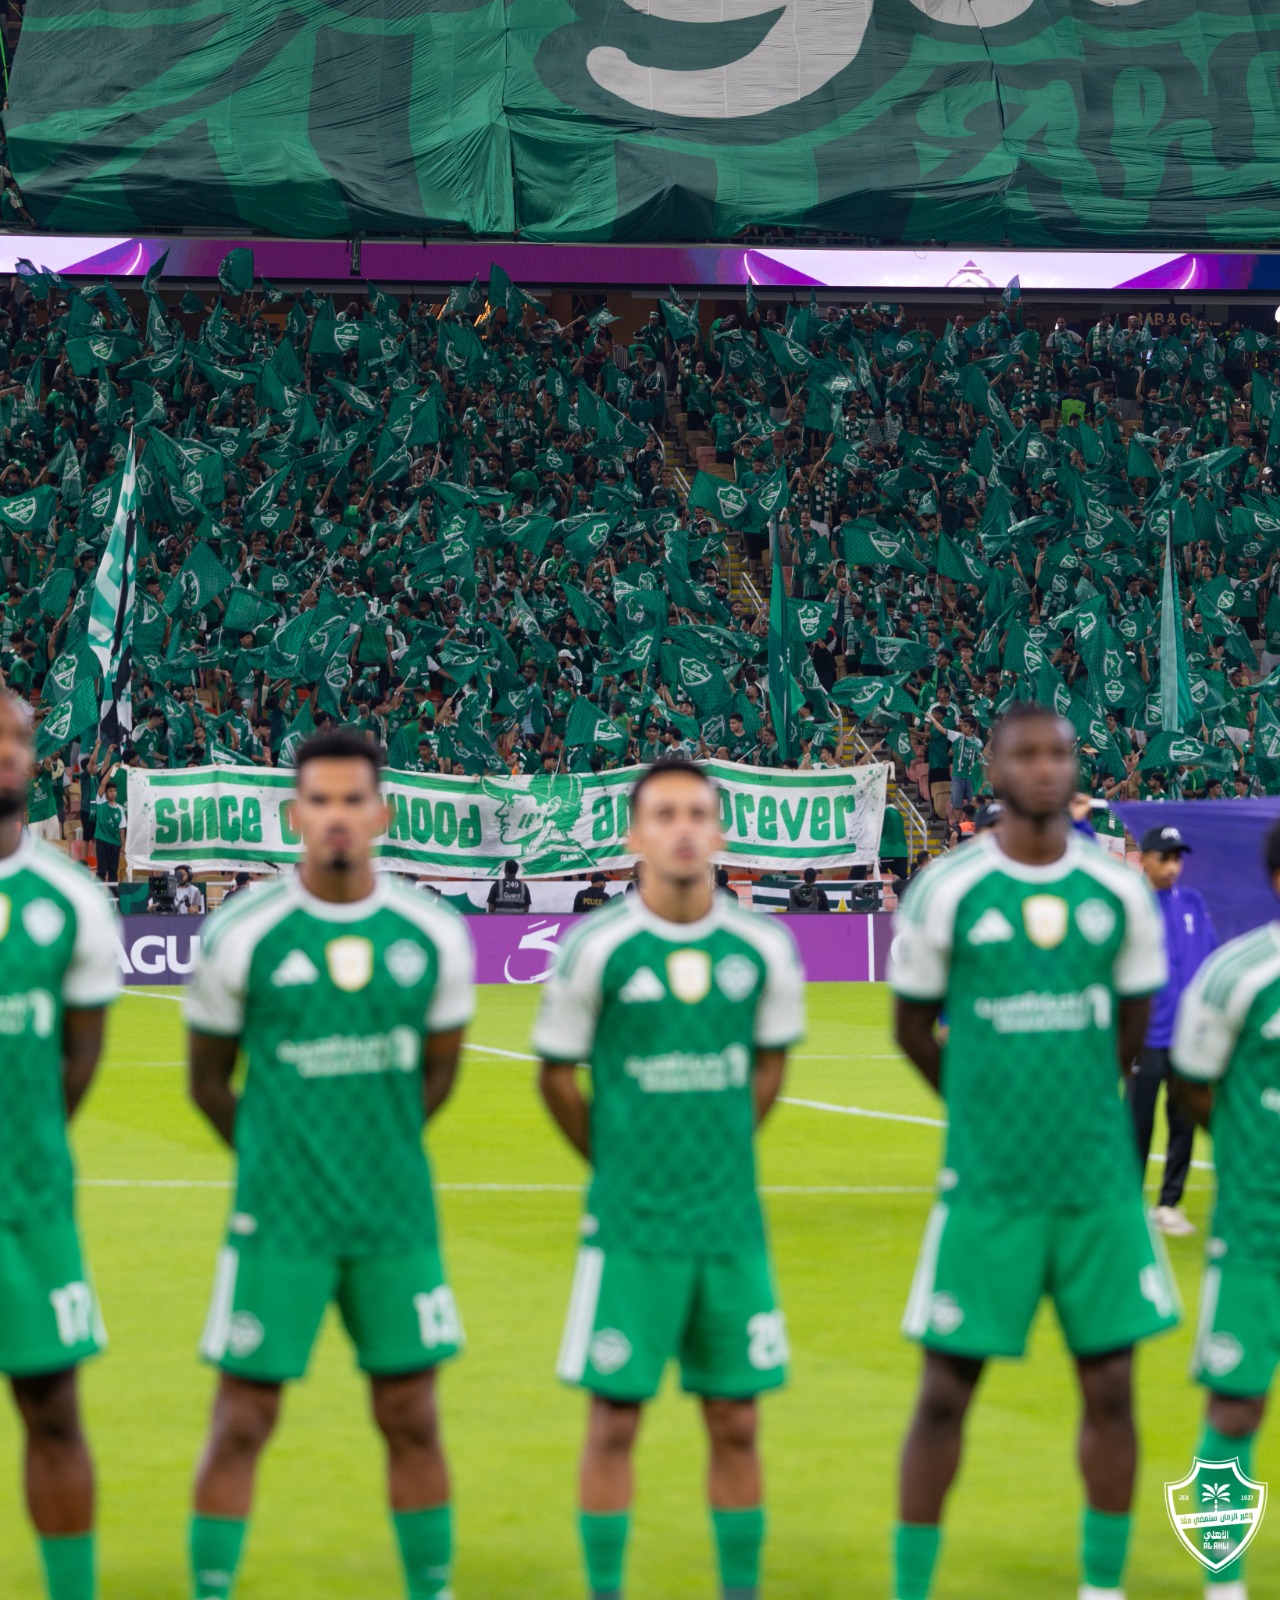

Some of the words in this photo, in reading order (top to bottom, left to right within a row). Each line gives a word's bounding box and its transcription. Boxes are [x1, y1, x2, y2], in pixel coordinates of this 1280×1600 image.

[155, 795, 263, 844] since
[714, 787, 856, 842] orever
[583, 897, 602, 905] POLICE
